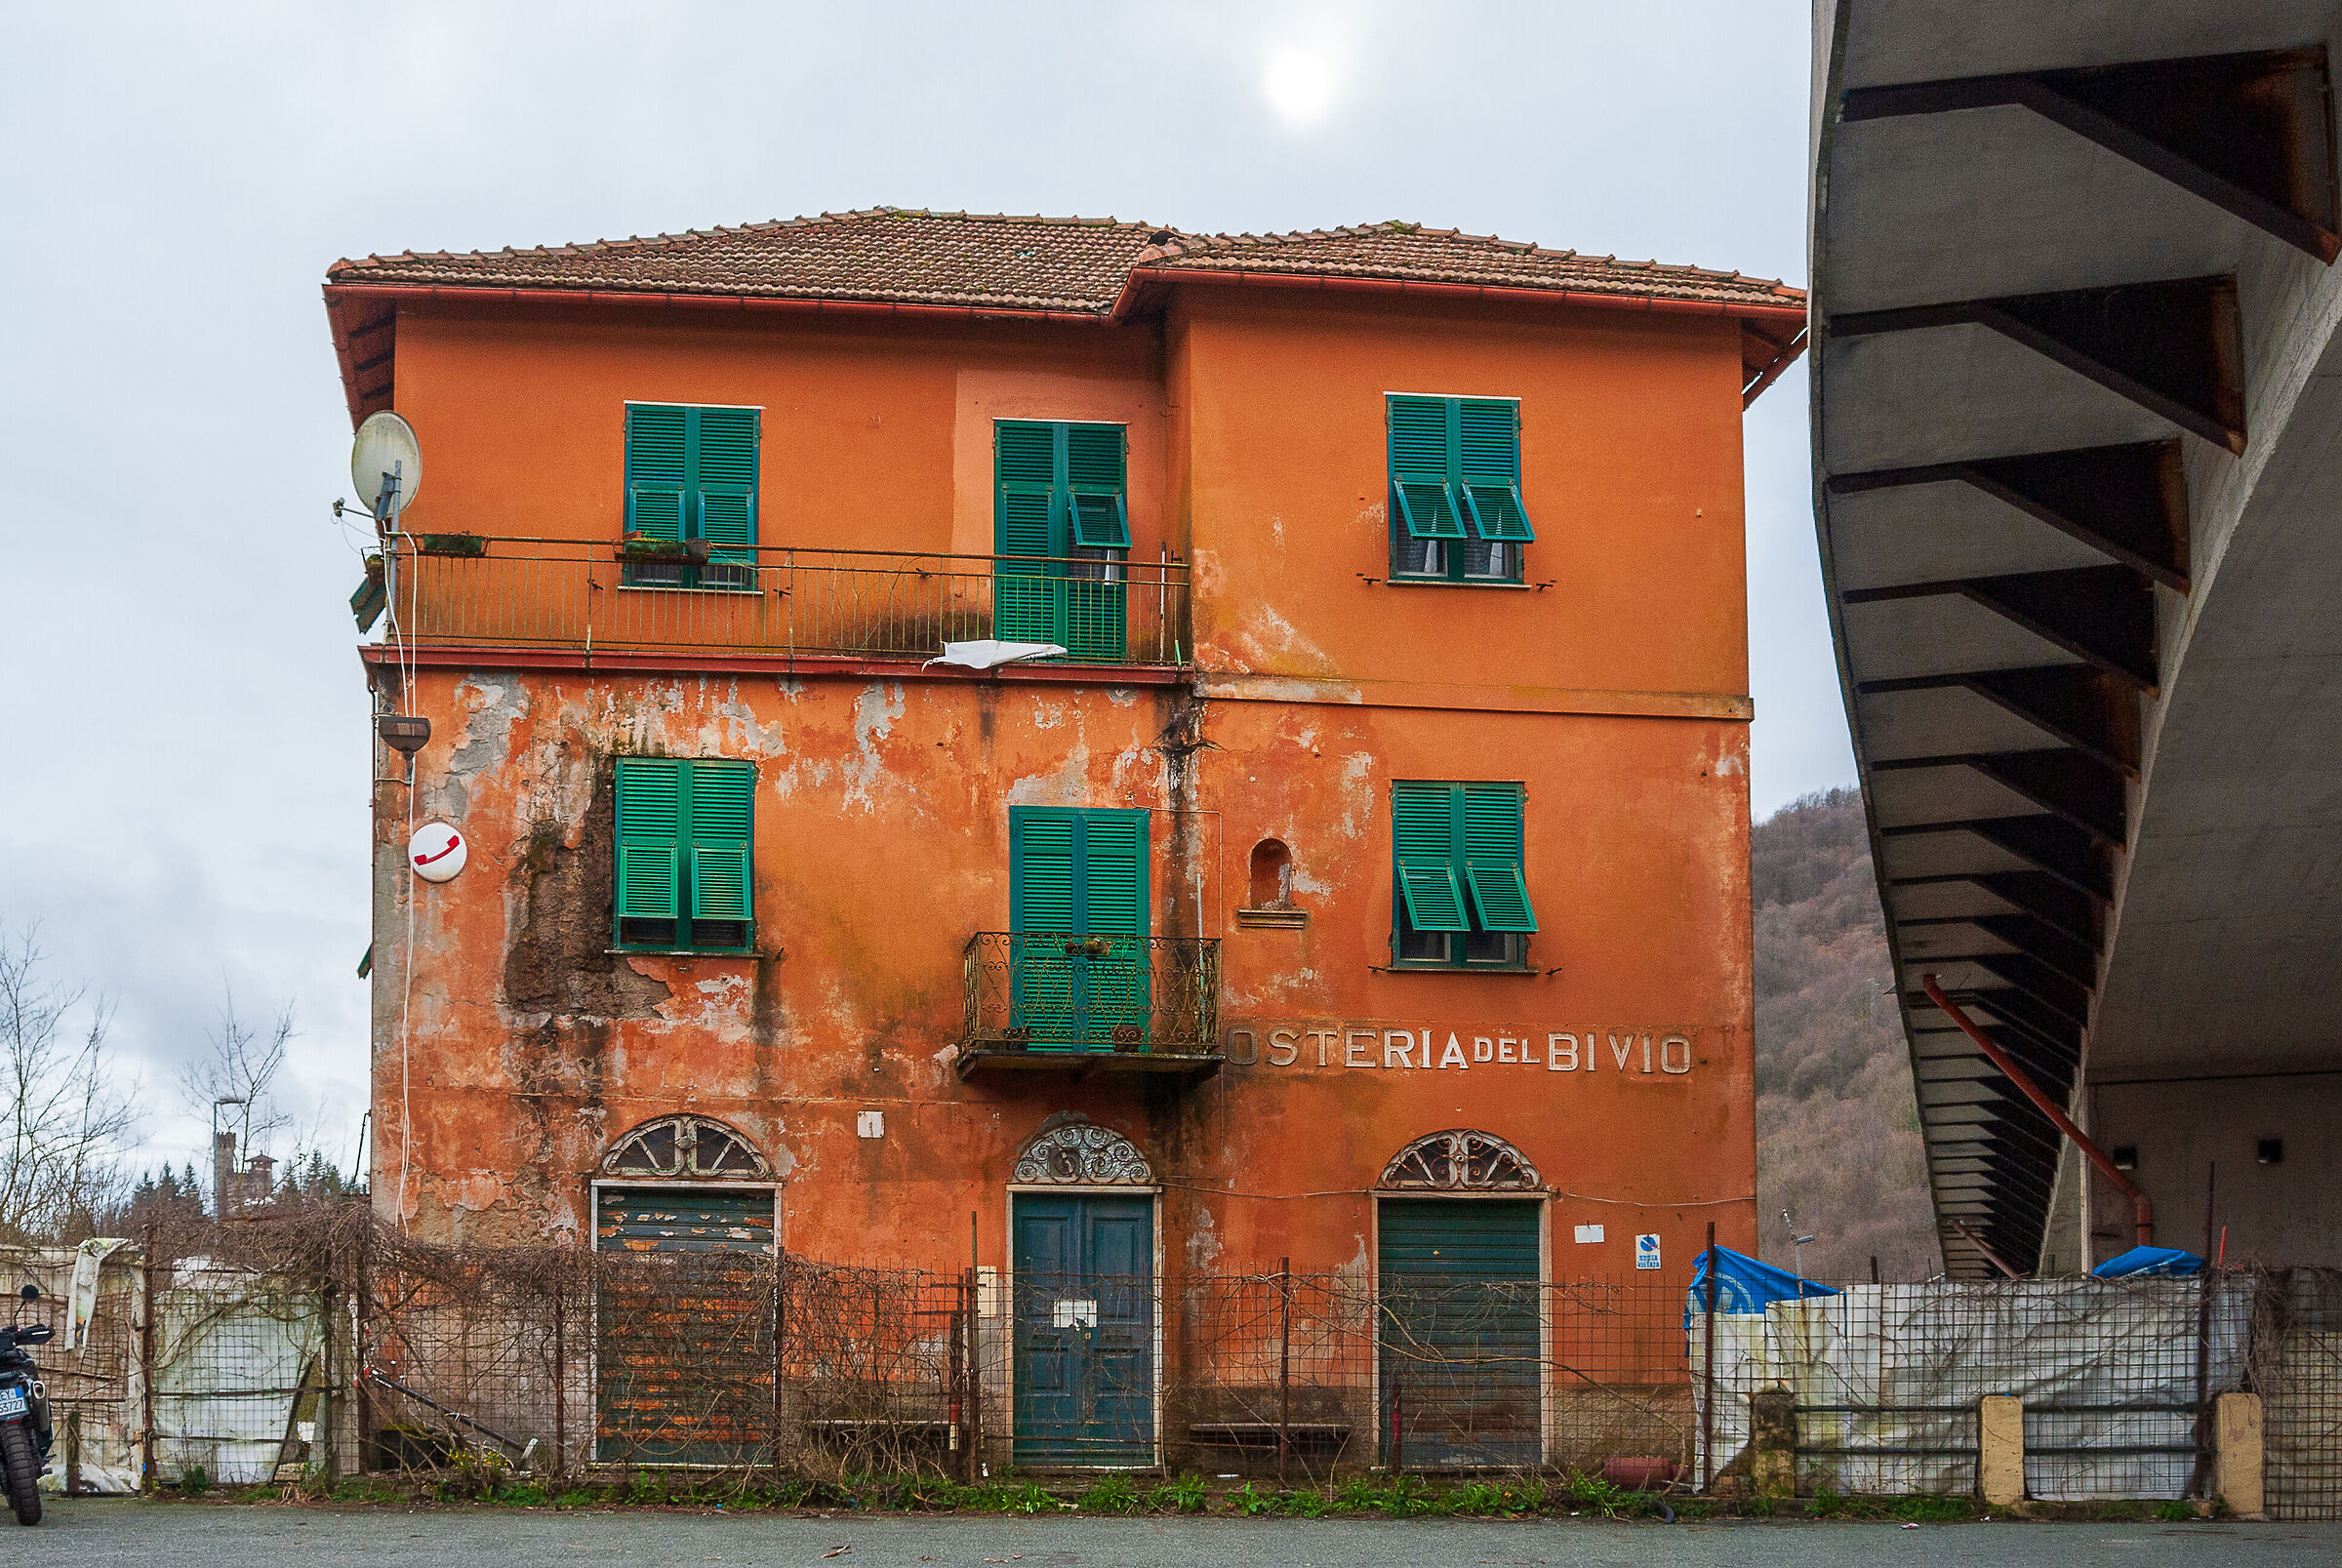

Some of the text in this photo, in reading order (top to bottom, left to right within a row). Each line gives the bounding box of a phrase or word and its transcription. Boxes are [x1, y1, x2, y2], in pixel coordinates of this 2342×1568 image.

[1227, 1025, 1692, 1074] OSTERIA DEL BIVIO
